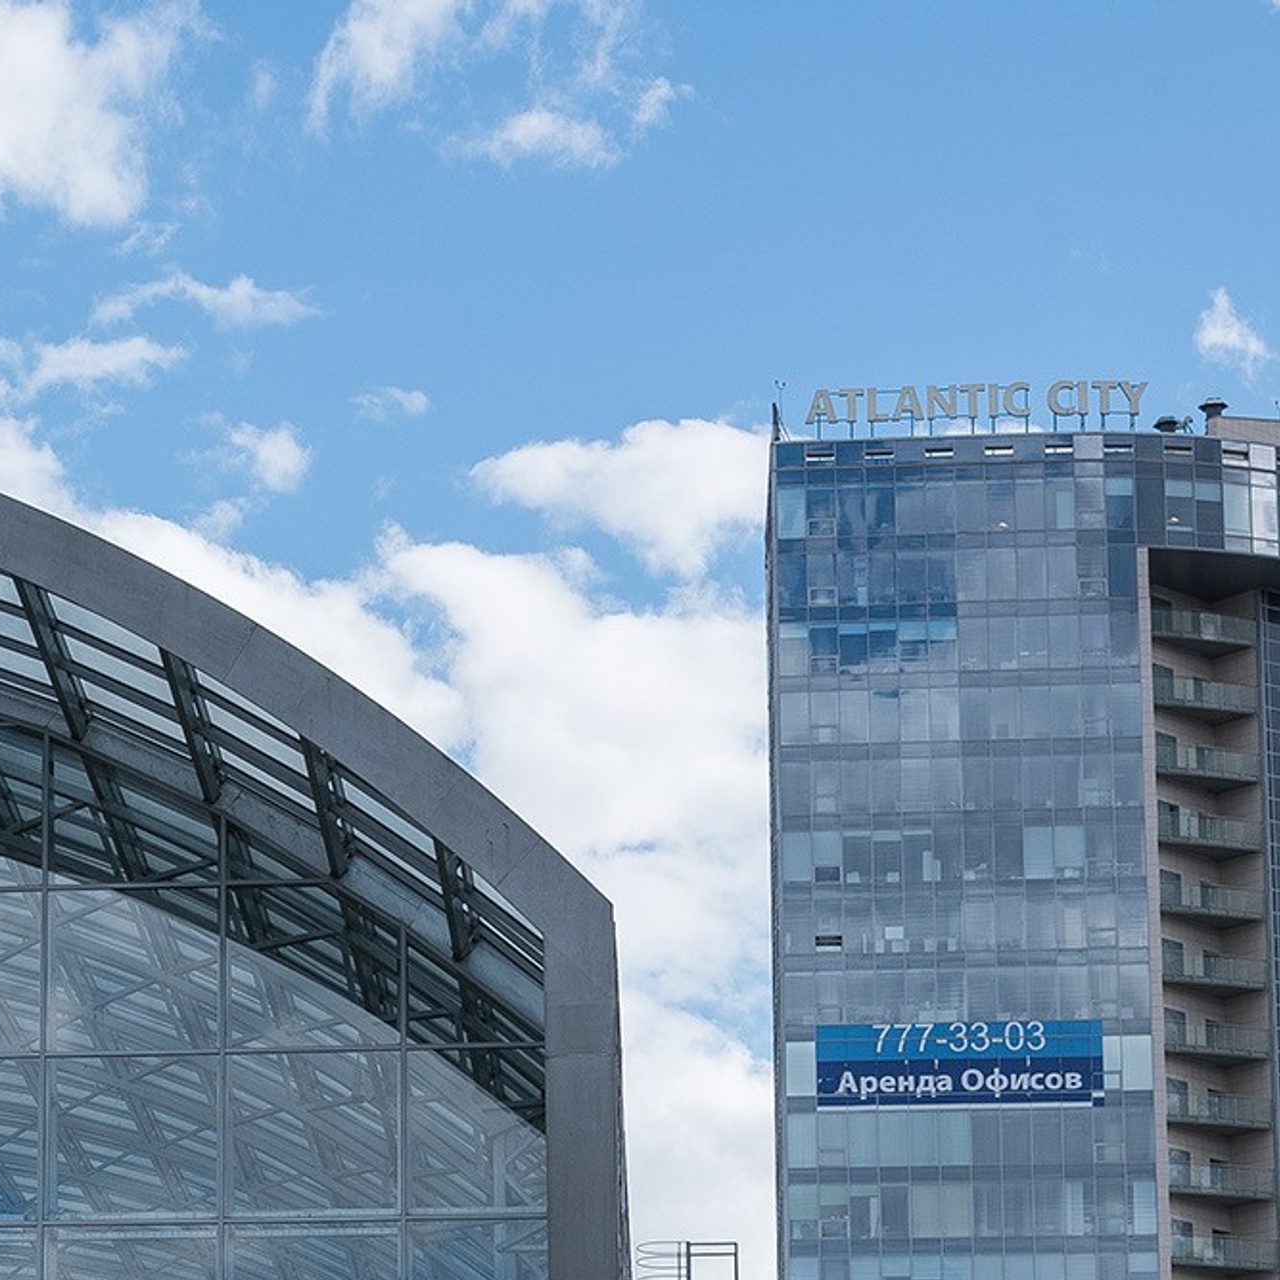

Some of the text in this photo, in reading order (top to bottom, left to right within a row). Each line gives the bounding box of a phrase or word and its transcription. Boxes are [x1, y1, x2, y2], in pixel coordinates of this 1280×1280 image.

[805, 379, 1149, 424] ATLANTIC CITY
[872, 1020, 1047, 1054] 777-33-03
[837, 1067, 1083, 1099] Аренда Офисов
